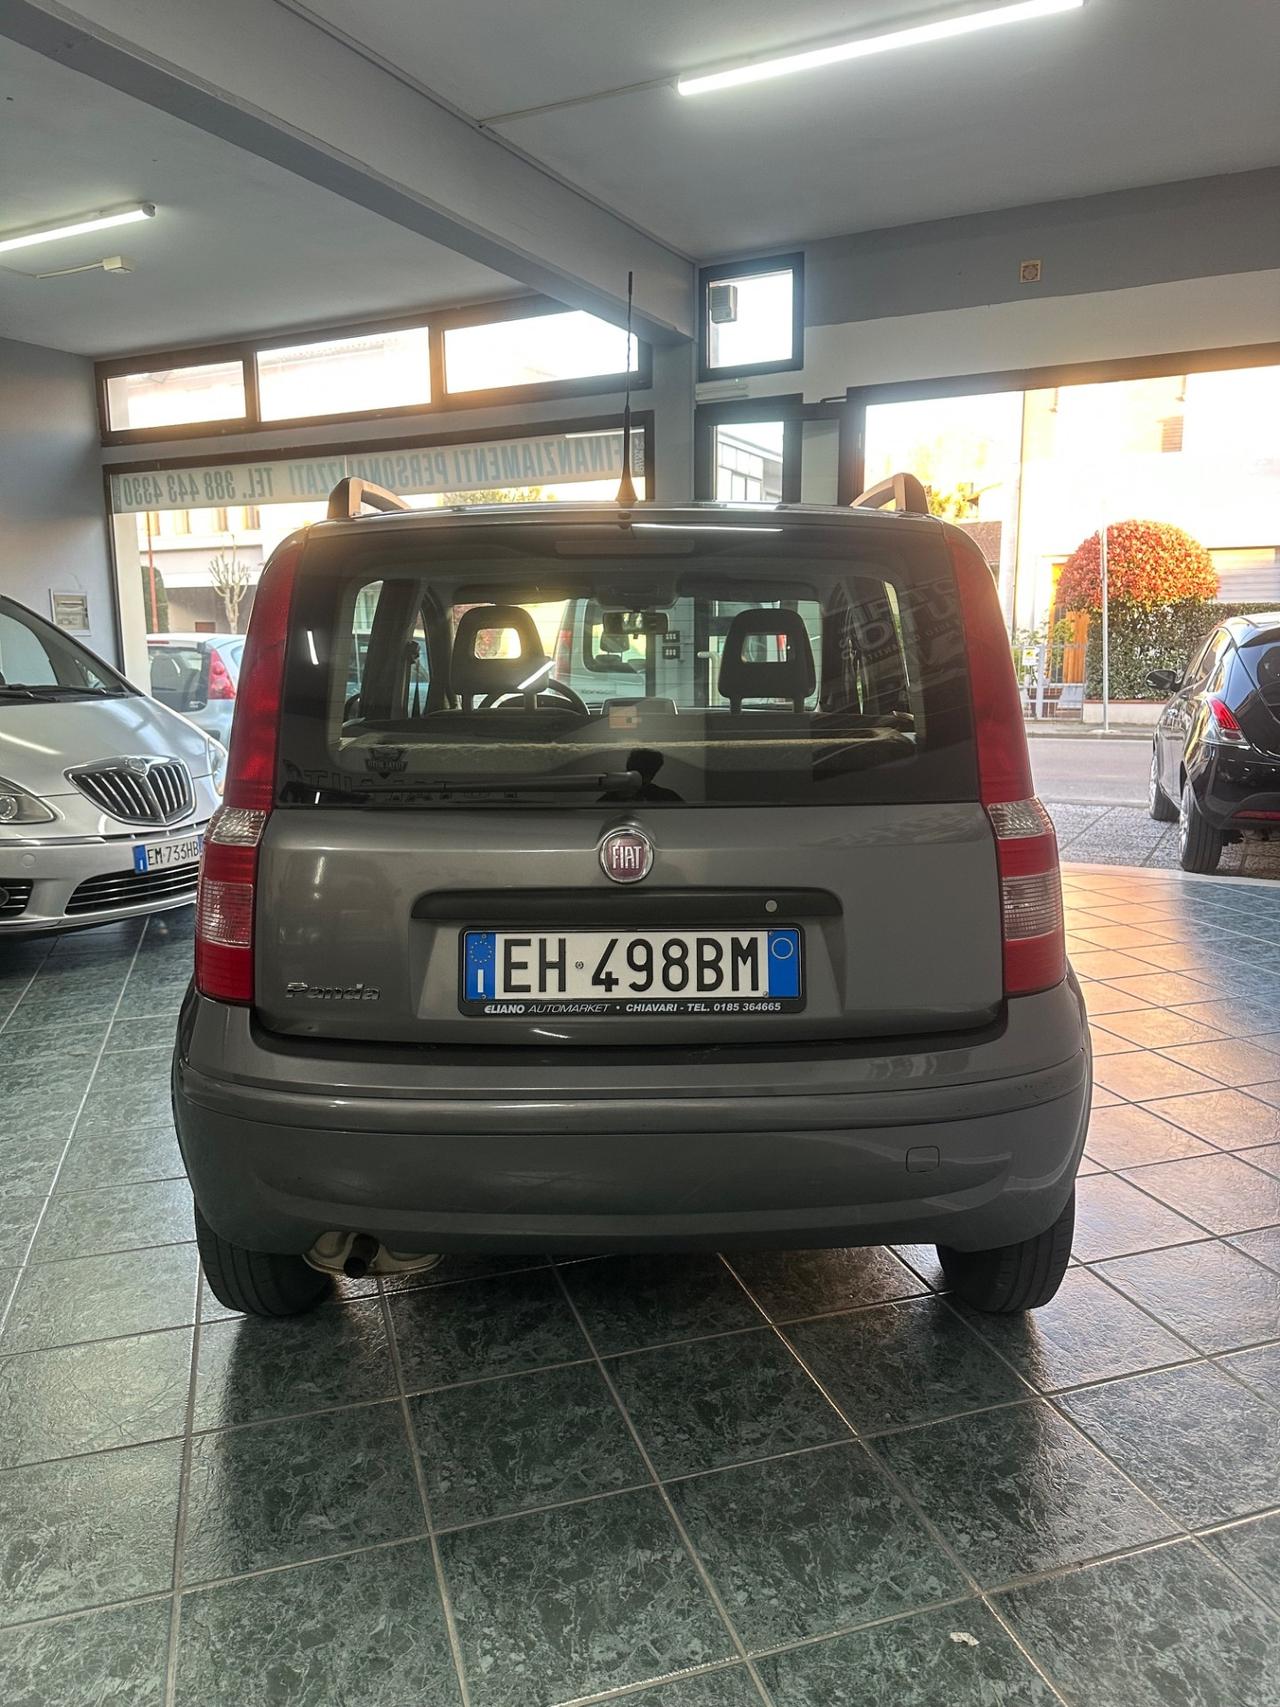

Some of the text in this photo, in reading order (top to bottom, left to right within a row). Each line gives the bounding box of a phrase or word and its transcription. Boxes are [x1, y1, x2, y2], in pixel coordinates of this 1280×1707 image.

[612, 846, 642, 869] FIAT
[503, 937, 759, 993] EH 498BM
[285, 982, 380, 1000] Panda
[484, 1003, 782, 1014] ELIANO AUTOMARKET CHIAVARI TEL. 0185 364665
